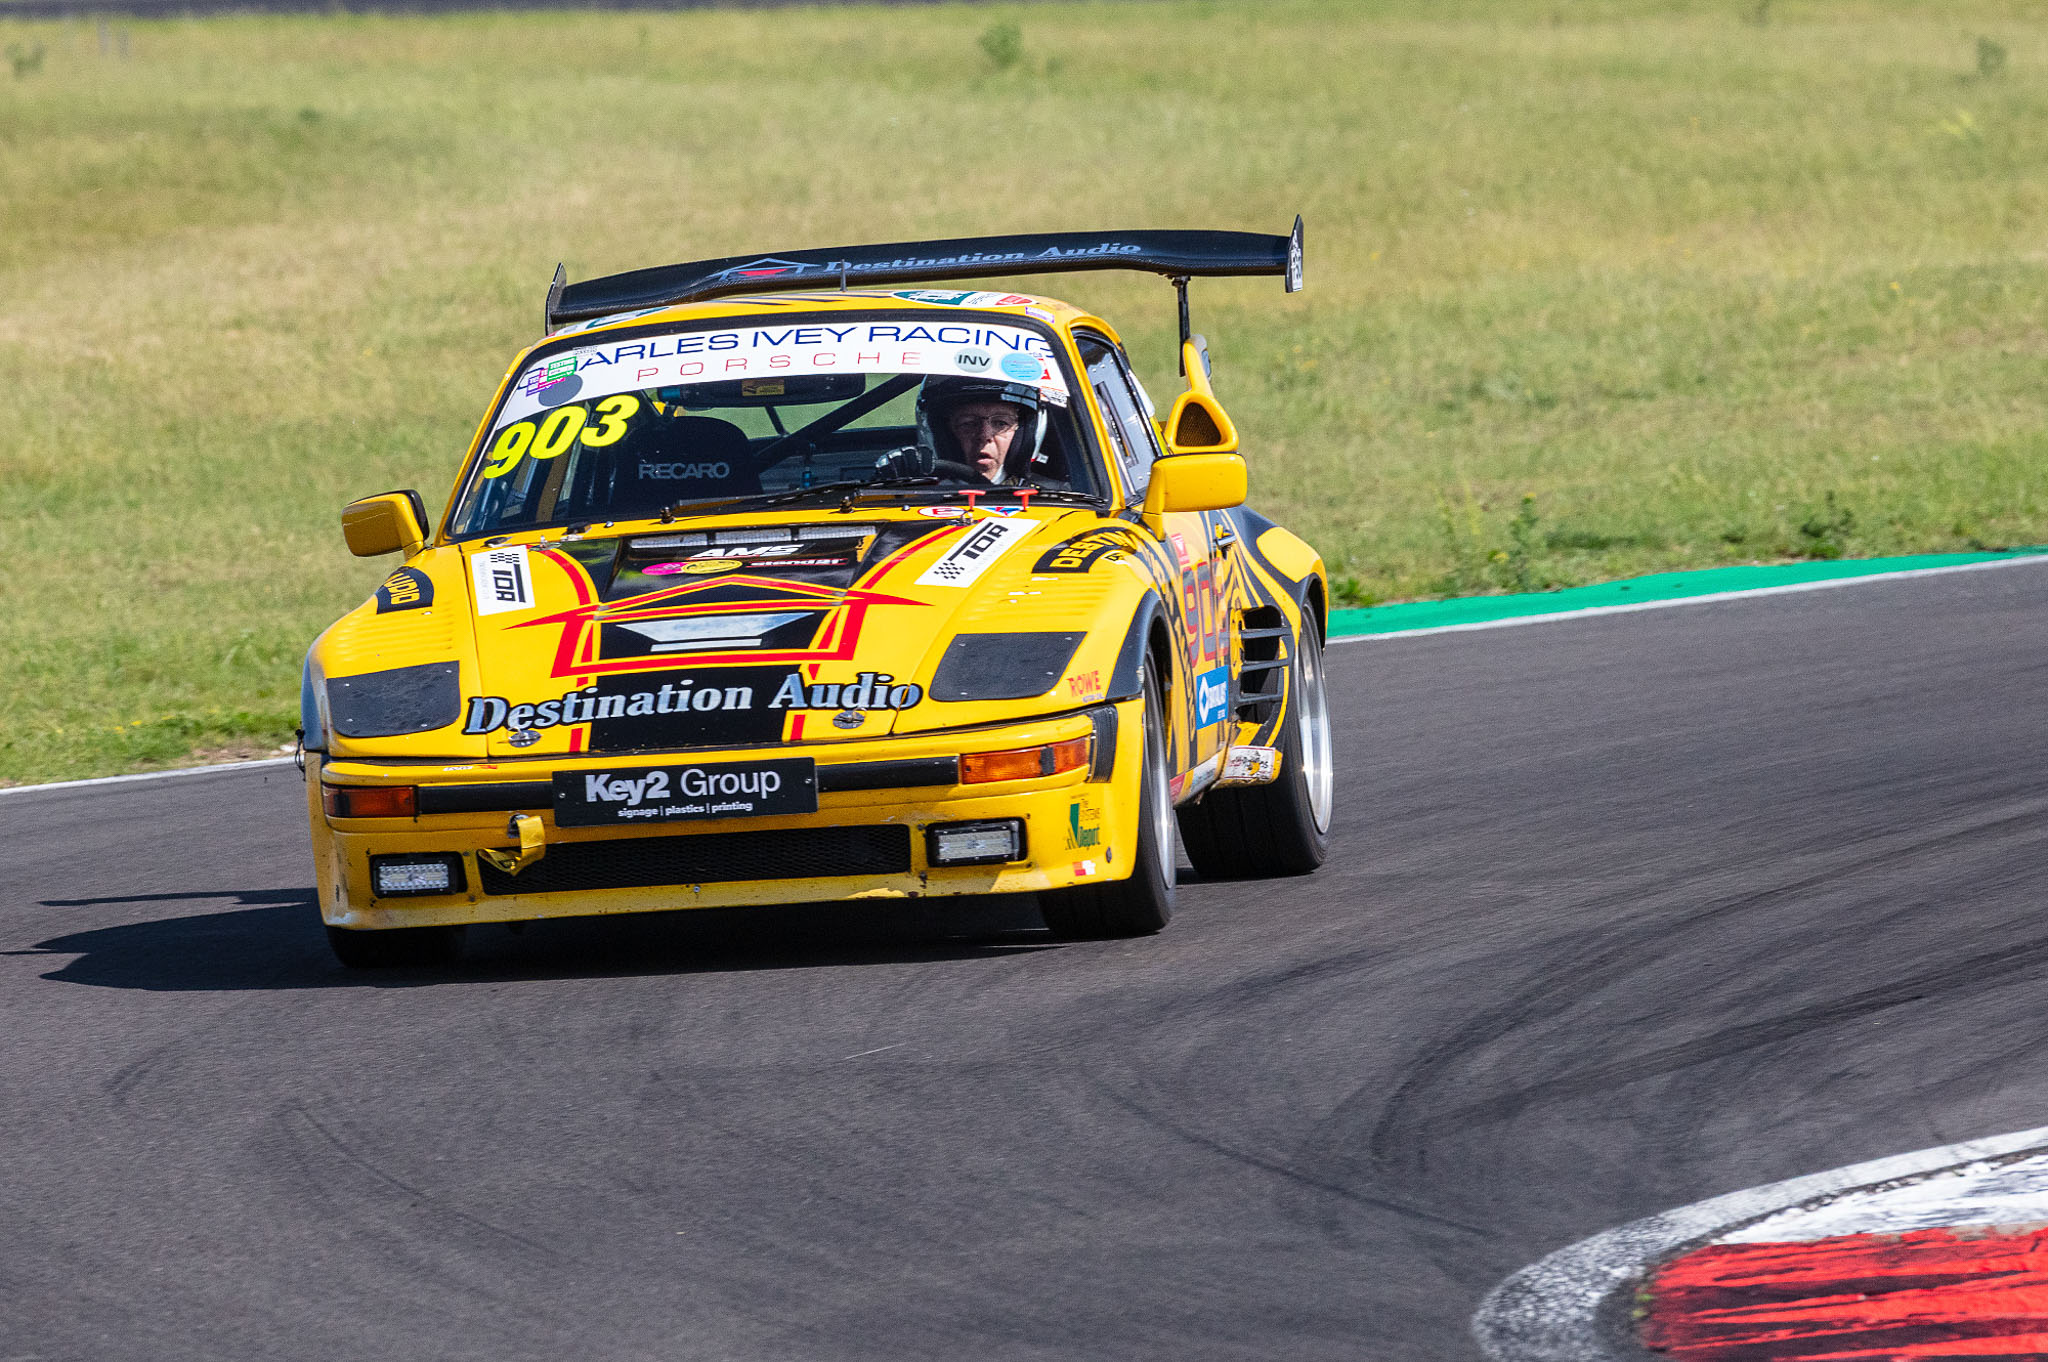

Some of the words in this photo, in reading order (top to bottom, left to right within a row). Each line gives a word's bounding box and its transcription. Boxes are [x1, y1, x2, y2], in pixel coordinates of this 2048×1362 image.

[823, 252, 1025, 273] Destination
[1033, 242, 1142, 259] Audio
[752, 326, 858, 348] IVEY
[637, 351, 921, 382] PORSCHE
[957, 354, 991, 367] INV
[484, 394, 640, 479] 903
[638, 461, 731, 481] RECARO
[689, 544, 806, 558] AMS
[1067, 669, 1101, 698] ROWE
[463, 679, 753, 735] Destination
[767, 670, 924, 711] Audio
[585, 771, 671, 805] Key2
[679, 768, 781, 800] Group
[618, 805, 659, 818] signage
[665, 801, 704, 815] plastics
[711, 800, 753, 814] printing
